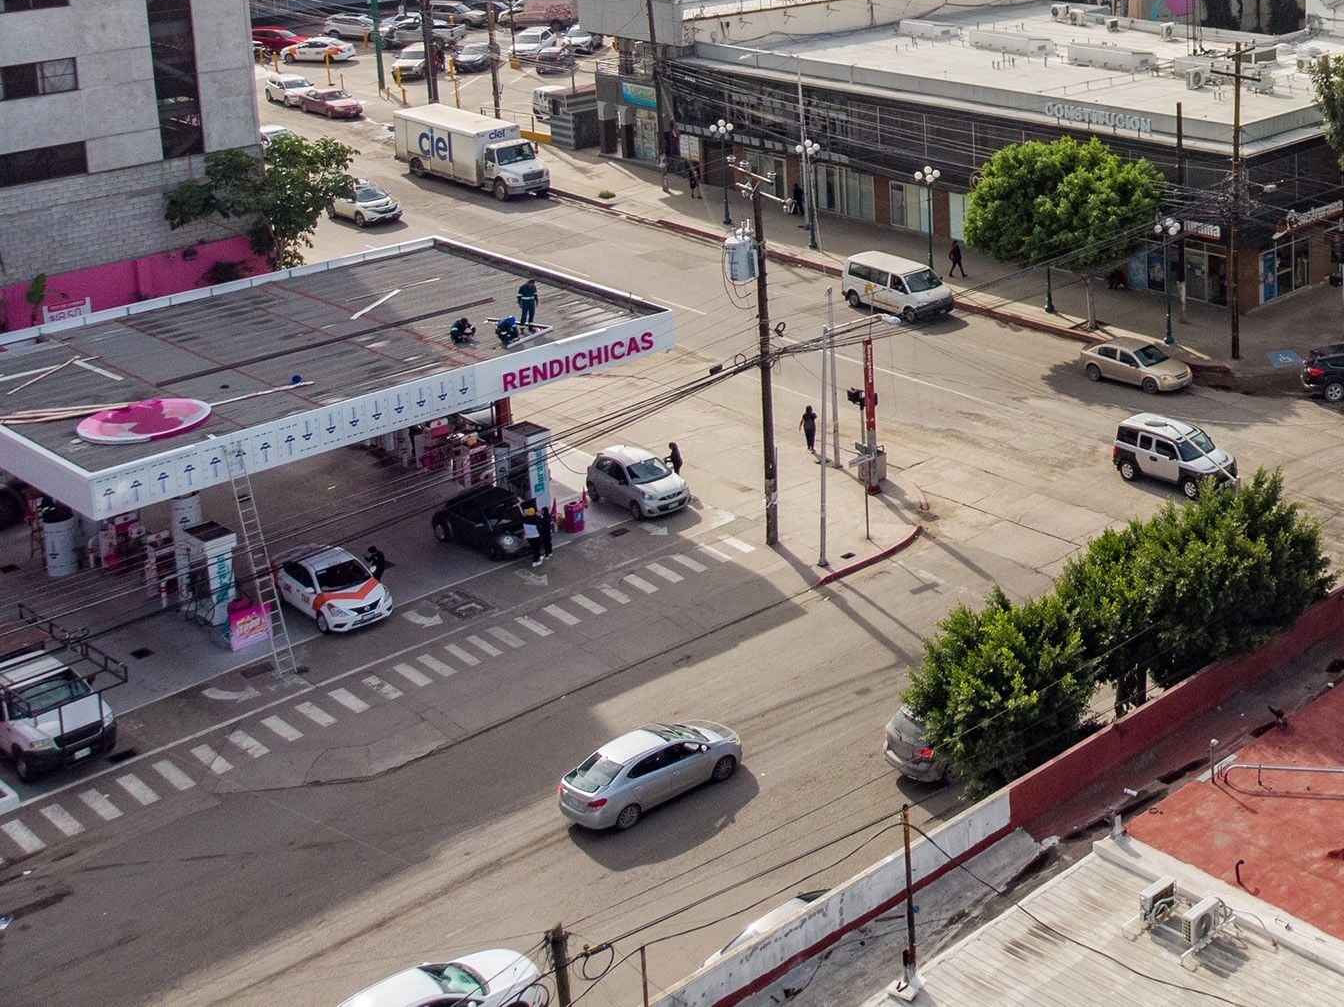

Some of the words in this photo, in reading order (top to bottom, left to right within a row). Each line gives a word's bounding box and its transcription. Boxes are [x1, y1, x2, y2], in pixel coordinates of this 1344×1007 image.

[418, 127, 453, 162] ciel
[489, 129, 506, 140] ciel
[502, 332, 655, 392] RENDICHICAS
